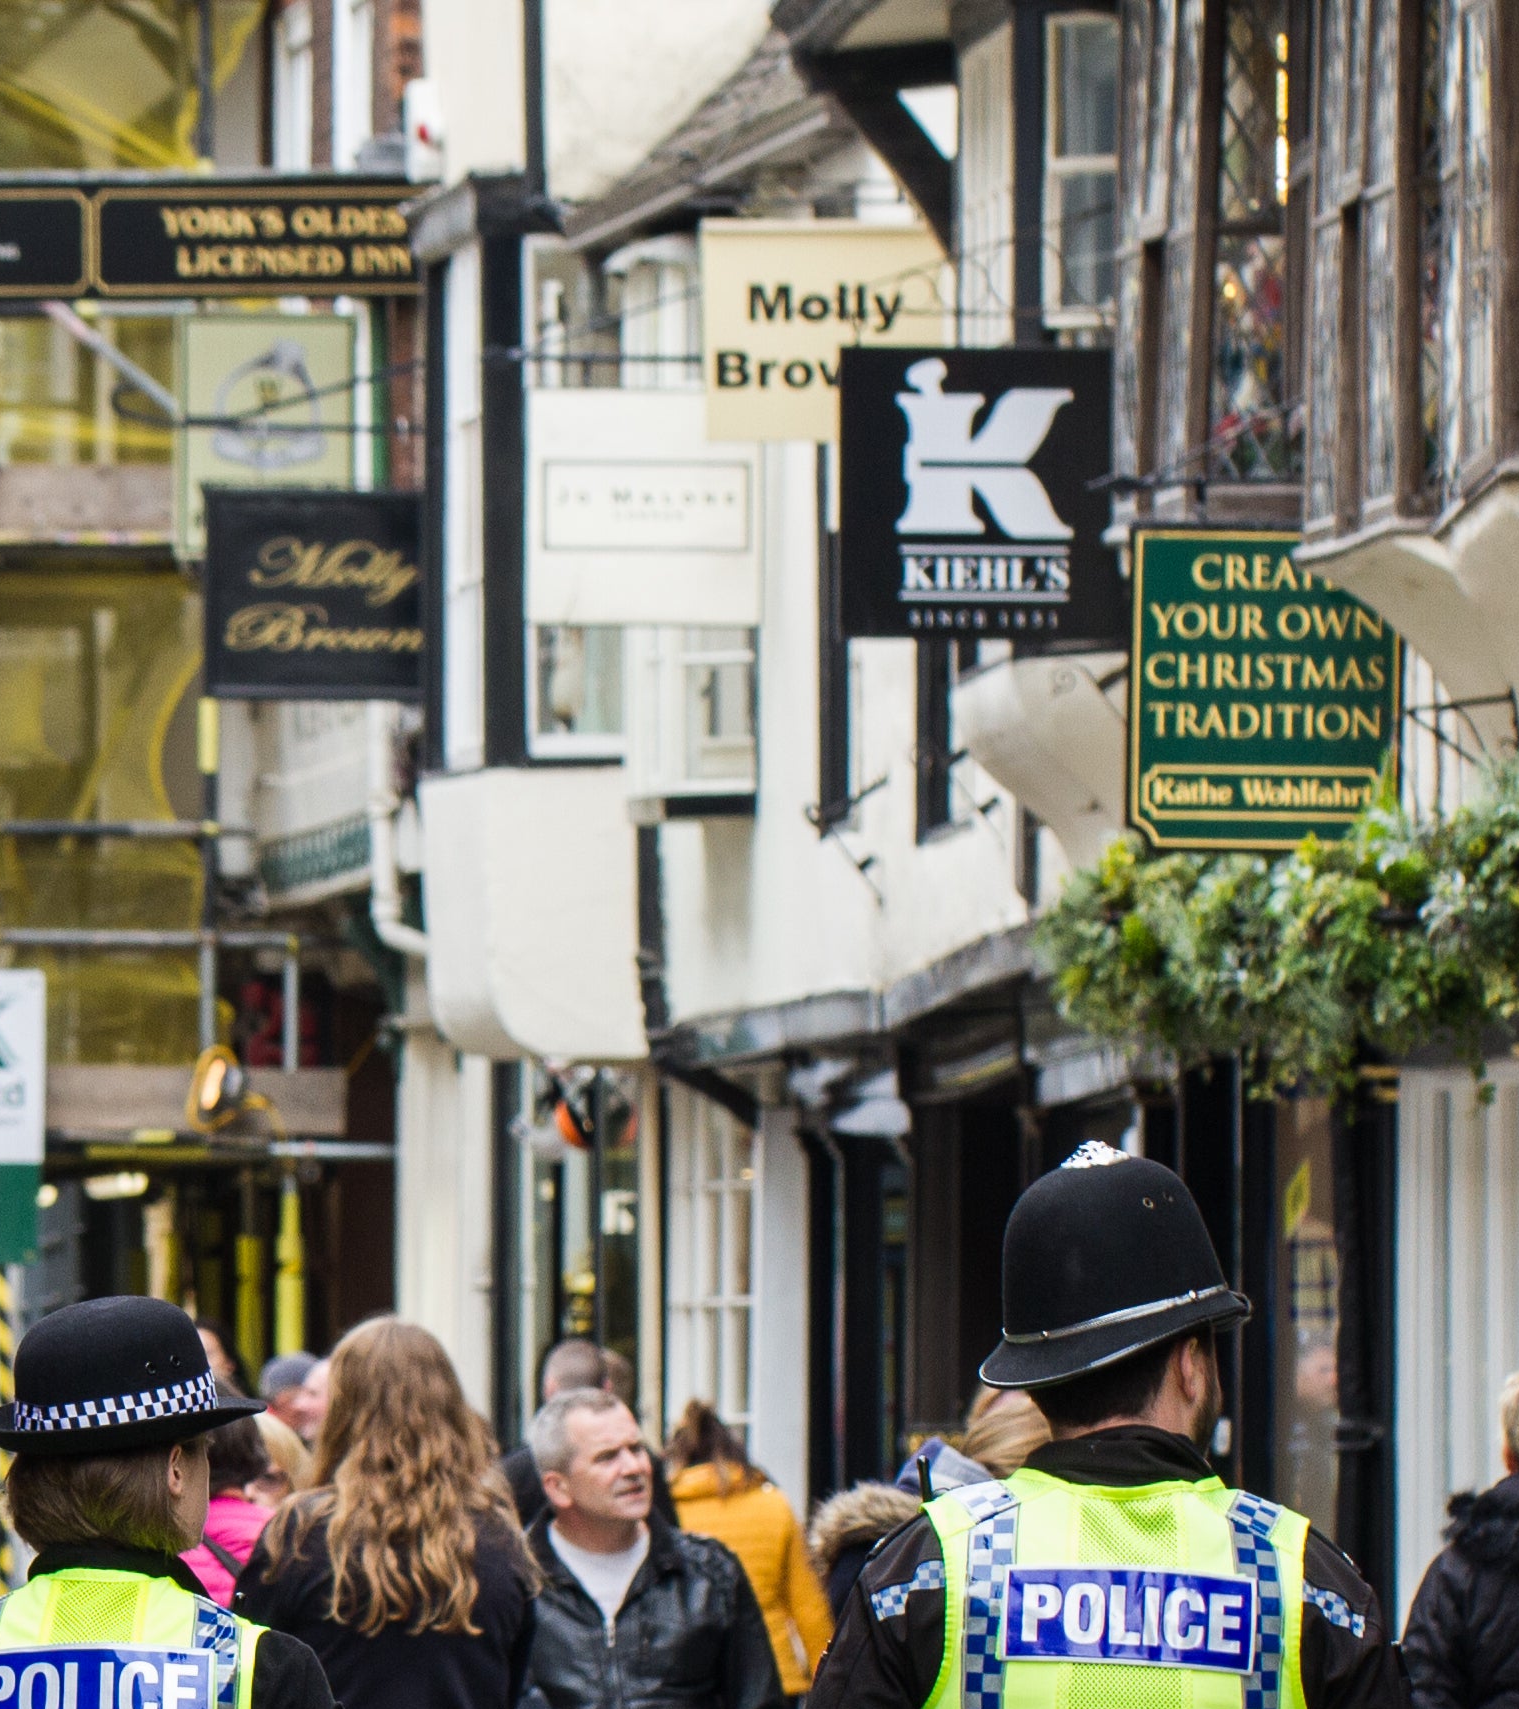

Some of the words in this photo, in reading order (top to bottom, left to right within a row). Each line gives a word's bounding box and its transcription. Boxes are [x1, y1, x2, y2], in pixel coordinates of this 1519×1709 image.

[160, 205, 287, 240] YORK'S
[290, 205, 409, 240] OLDES
[175, 244, 347, 279] LICENSED
[351, 244, 413, 278] INN
[747, 282, 902, 334] Molly
[247, 535, 424, 608] Molly
[901, 556, 1071, 590] KIEHL'S
[224, 601, 425, 653] Brown
[1149, 602, 1269, 641] YOUR
[1277, 603, 1384, 642] OWN
[1144, 651, 1385, 691] CHRISTMAS
[1146, 701, 1382, 741] TRADITION
[1240, 777, 1373, 807] Wohlfahrt
[1019, 1581, 1242, 1654] POLICE
